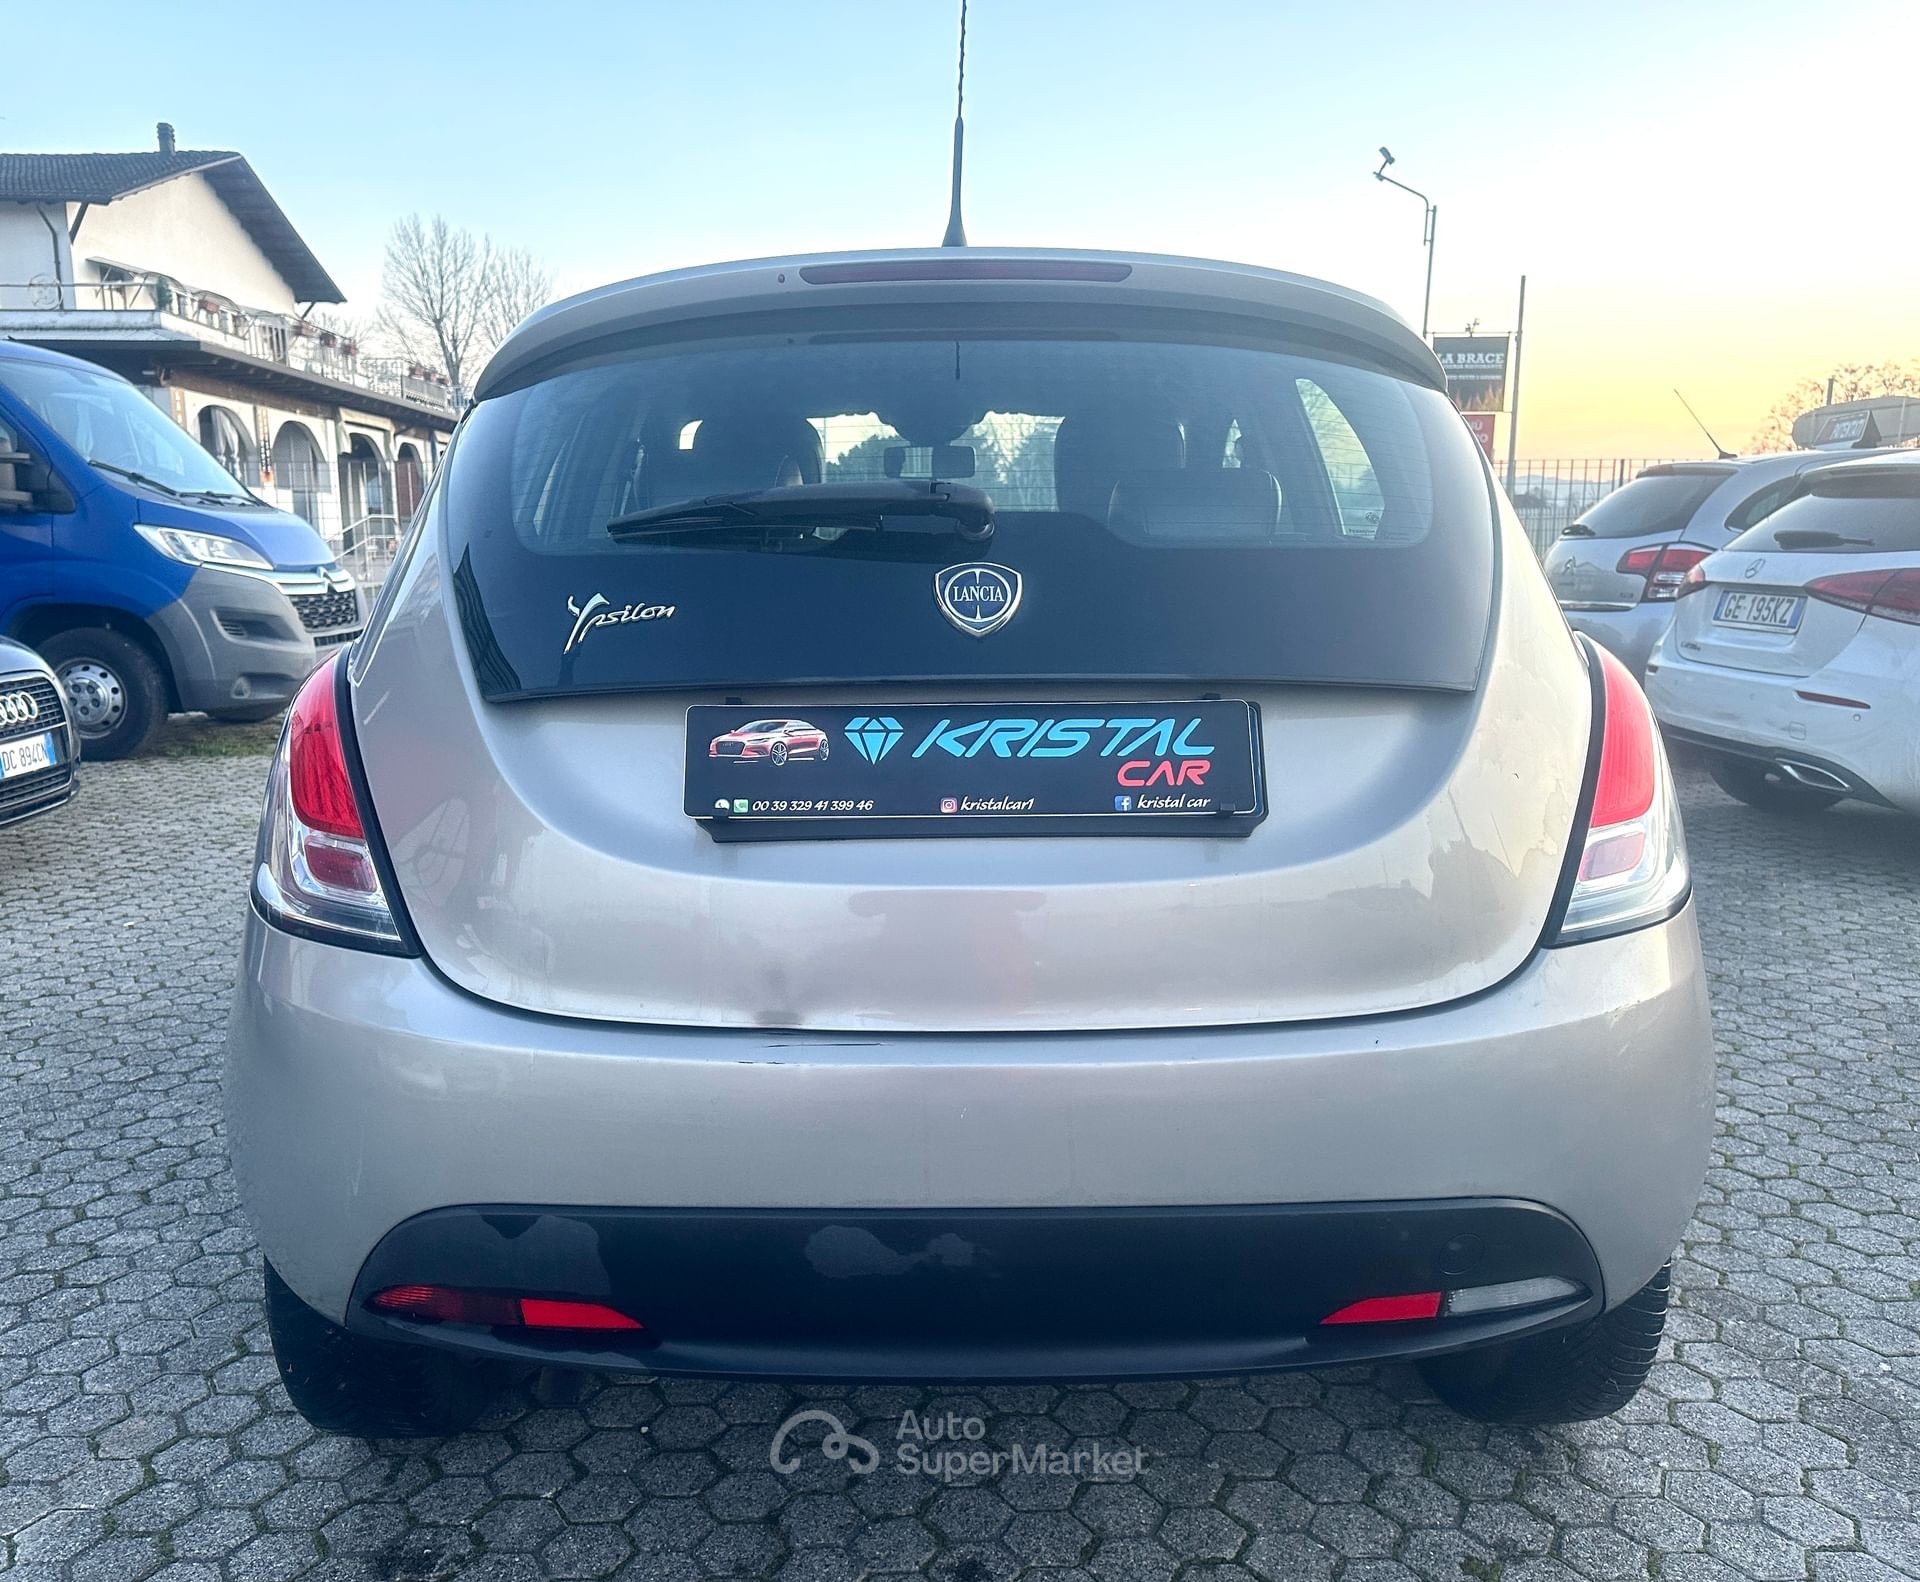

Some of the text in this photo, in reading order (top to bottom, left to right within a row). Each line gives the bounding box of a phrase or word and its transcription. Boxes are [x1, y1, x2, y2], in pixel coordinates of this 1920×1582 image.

[1457, 353, 1504, 364] BRACE
[953, 586, 1005, 602] LANCIA
[1724, 595, 1796, 624] GE 195KZ
[564, 592, 676, 655] Ypsilon
[911, 718, 1215, 758] KRISTAL
[2, 750, 17, 771] DC
[1117, 760, 1211, 787] CAR
[752, 800, 874, 811] 00 39 329 41 399 46
[960, 796, 1035, 811] kristalcar1
[1137, 794, 1211, 810] kristal car
